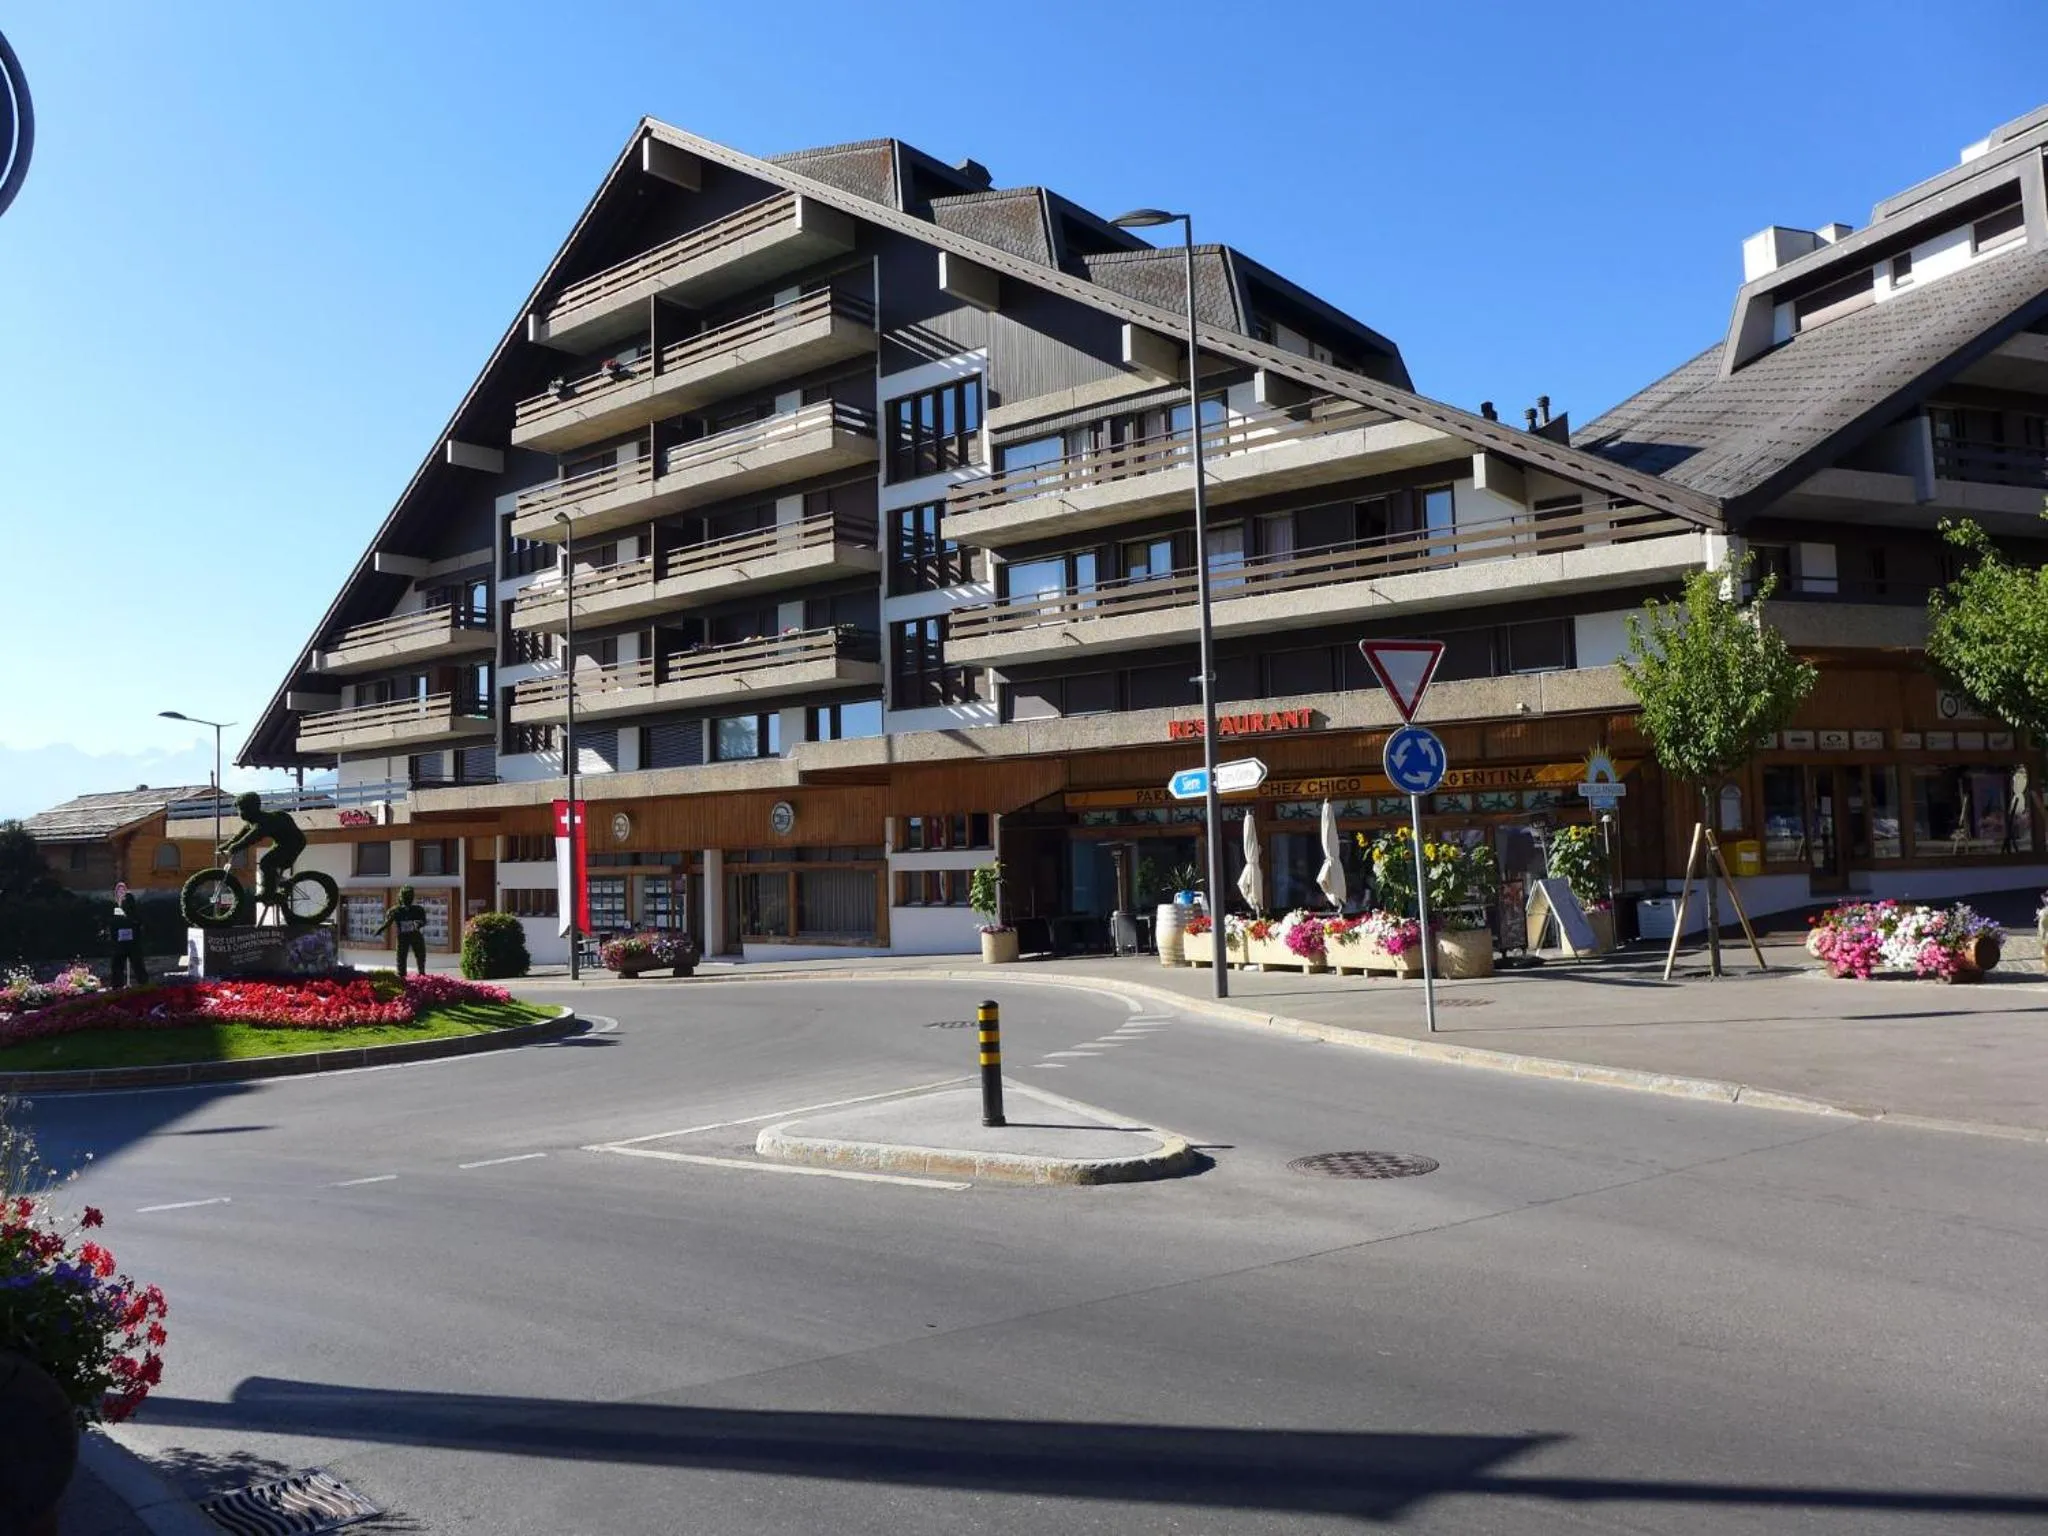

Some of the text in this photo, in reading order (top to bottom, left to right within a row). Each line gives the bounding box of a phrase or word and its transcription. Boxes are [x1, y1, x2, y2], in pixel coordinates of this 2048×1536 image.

[1169, 708, 1313, 738] RESAURANT
[1258, 780, 1300, 796] CHEZ
[1307, 778, 1360, 793] CHICO
[1442, 768, 1535, 786] GENTINA
